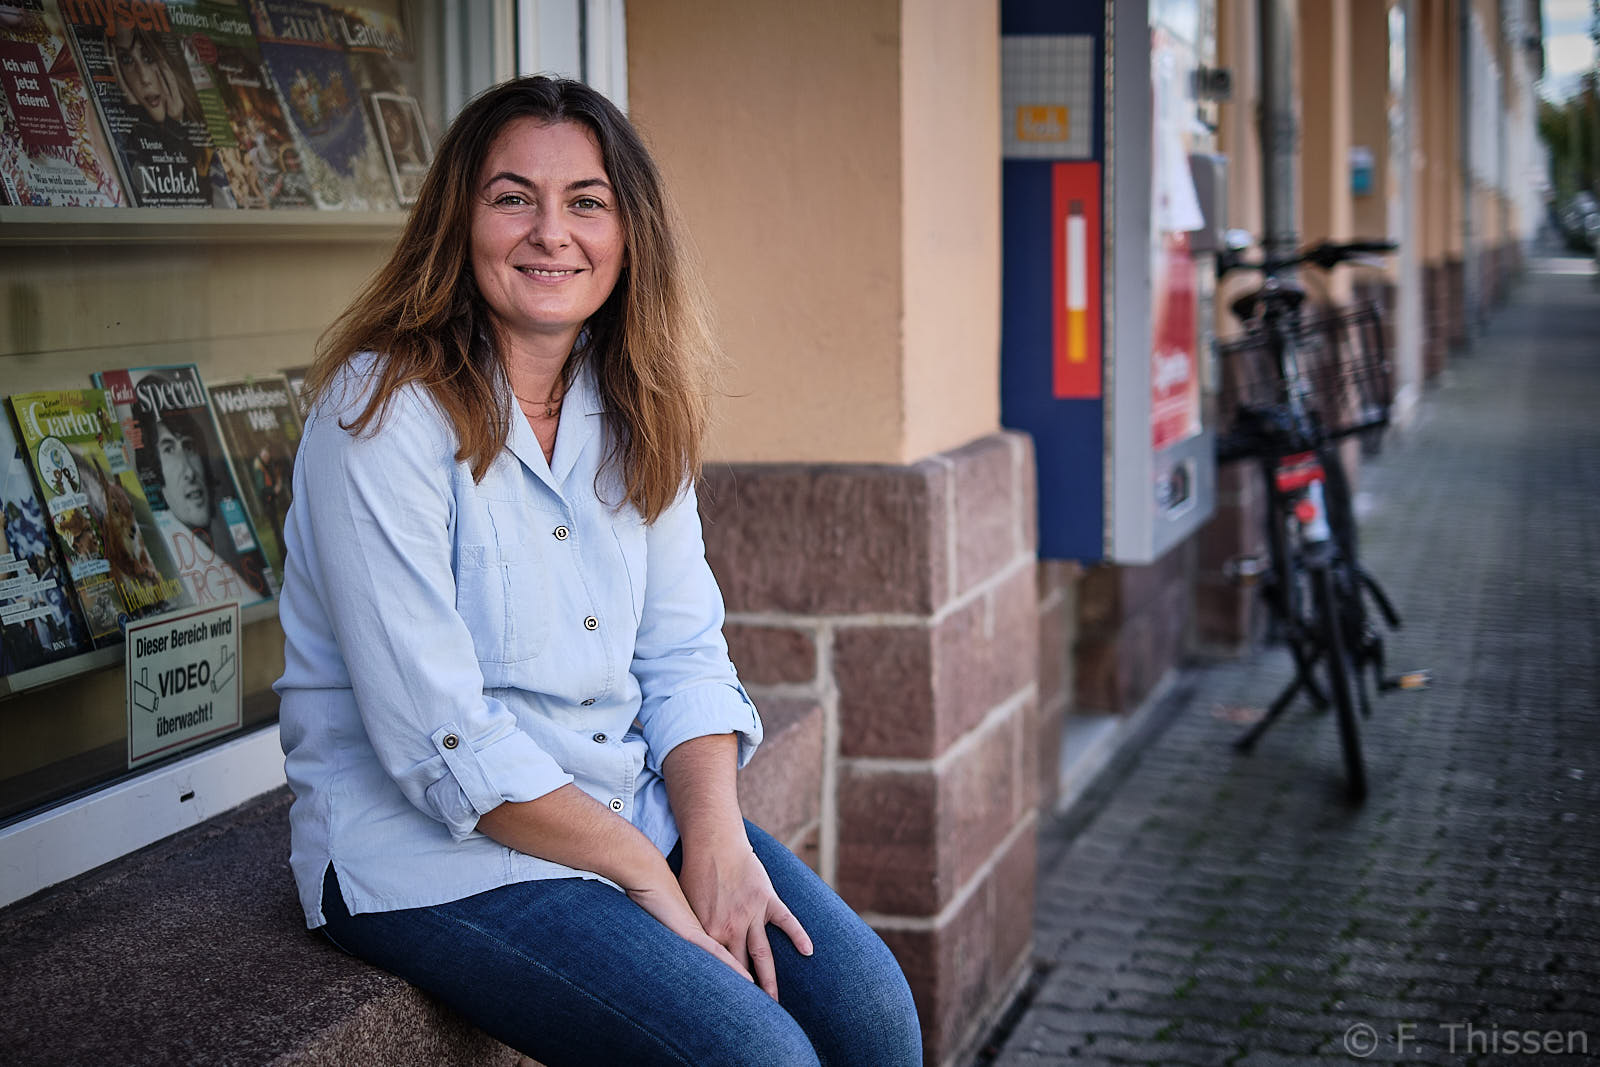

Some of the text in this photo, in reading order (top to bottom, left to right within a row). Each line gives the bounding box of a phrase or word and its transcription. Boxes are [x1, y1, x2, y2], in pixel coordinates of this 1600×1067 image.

[2, 58, 40, 74] Ich will
[13, 75, 40, 91] jetzt
[15, 92, 50, 108] feiern!
[138, 164, 201, 194] Nichts!
[136, 367, 206, 422] special
[29, 401, 102, 439] Garten
[136, 615, 232, 658] Dieser Bereich wird
[158, 660, 210, 698] VIDEO
